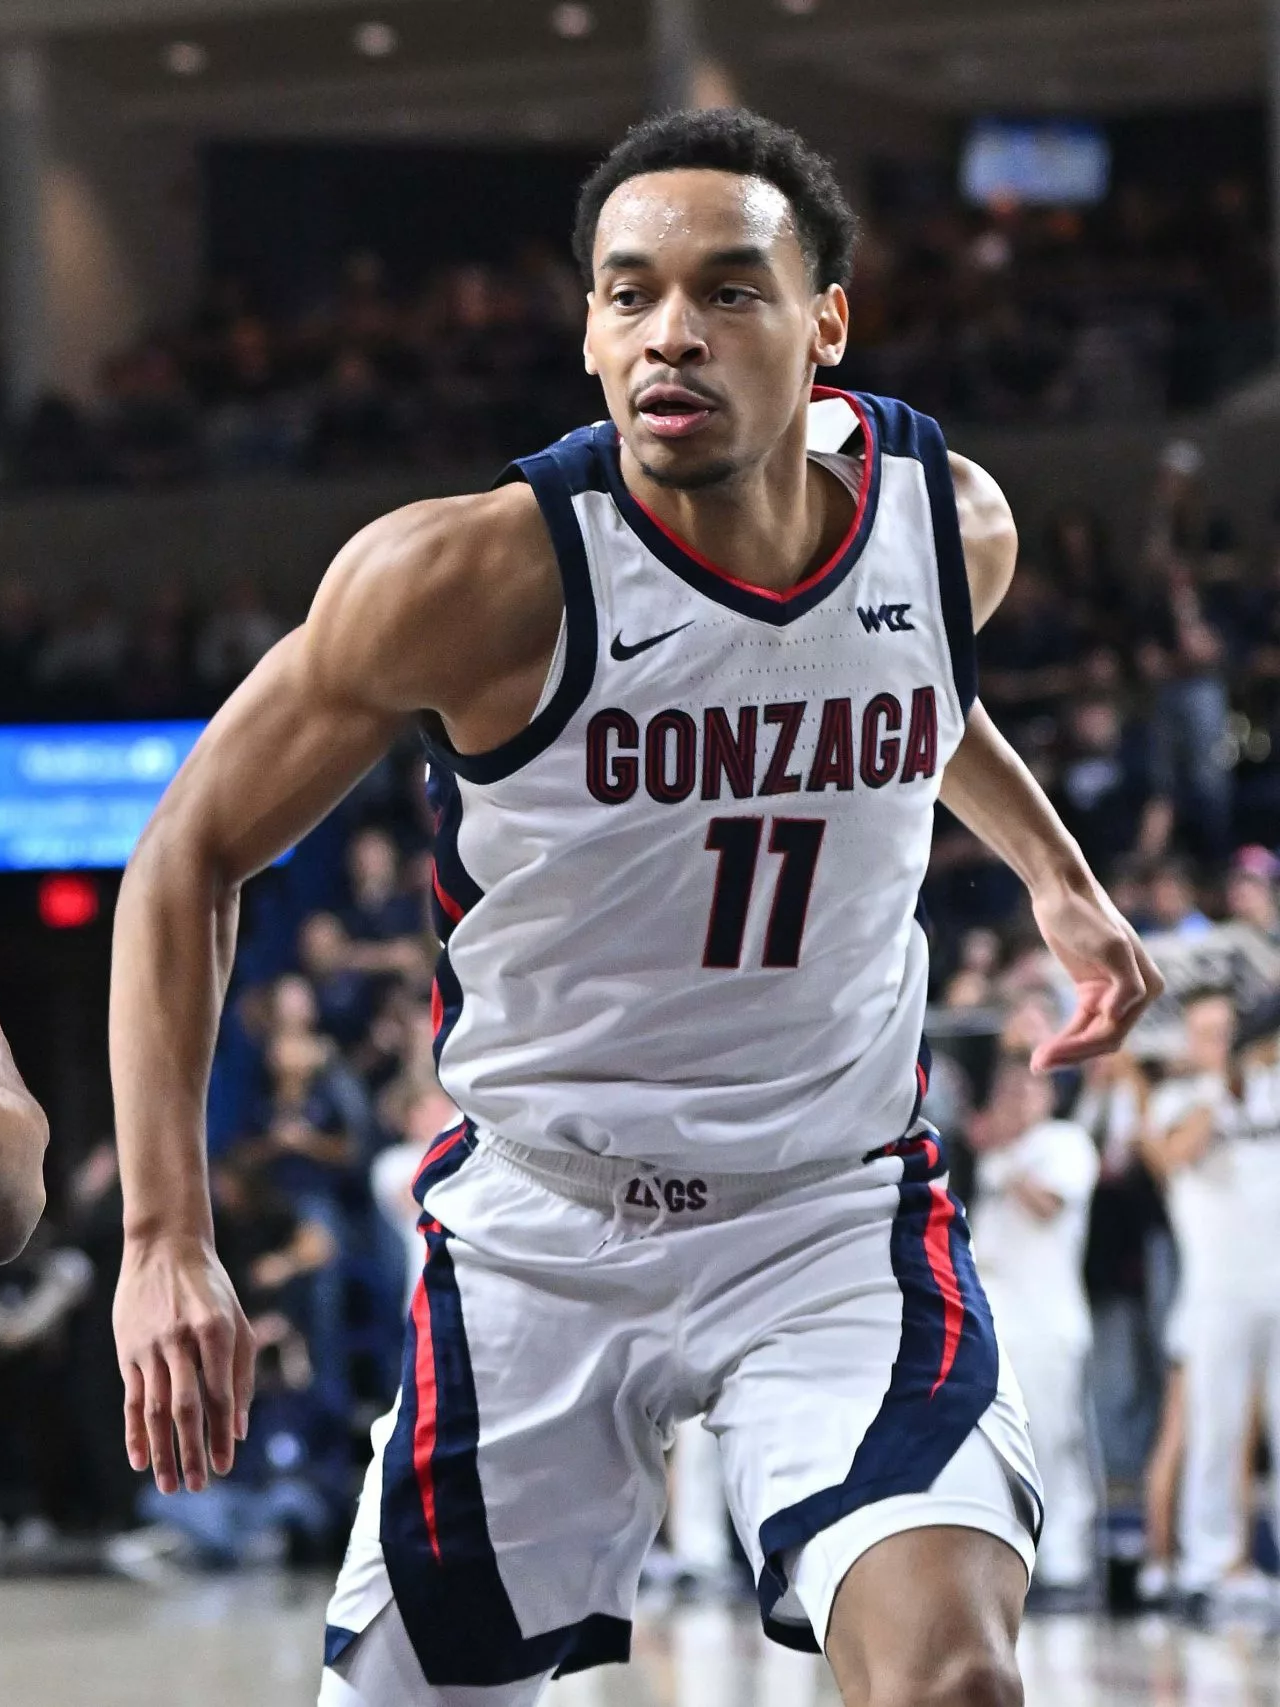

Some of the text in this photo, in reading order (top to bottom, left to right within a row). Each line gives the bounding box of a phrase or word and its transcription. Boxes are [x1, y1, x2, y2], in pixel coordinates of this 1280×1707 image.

[857, 604, 915, 633] WCC
[586, 686, 938, 804] GONZAGA
[702, 815, 826, 968] 11
